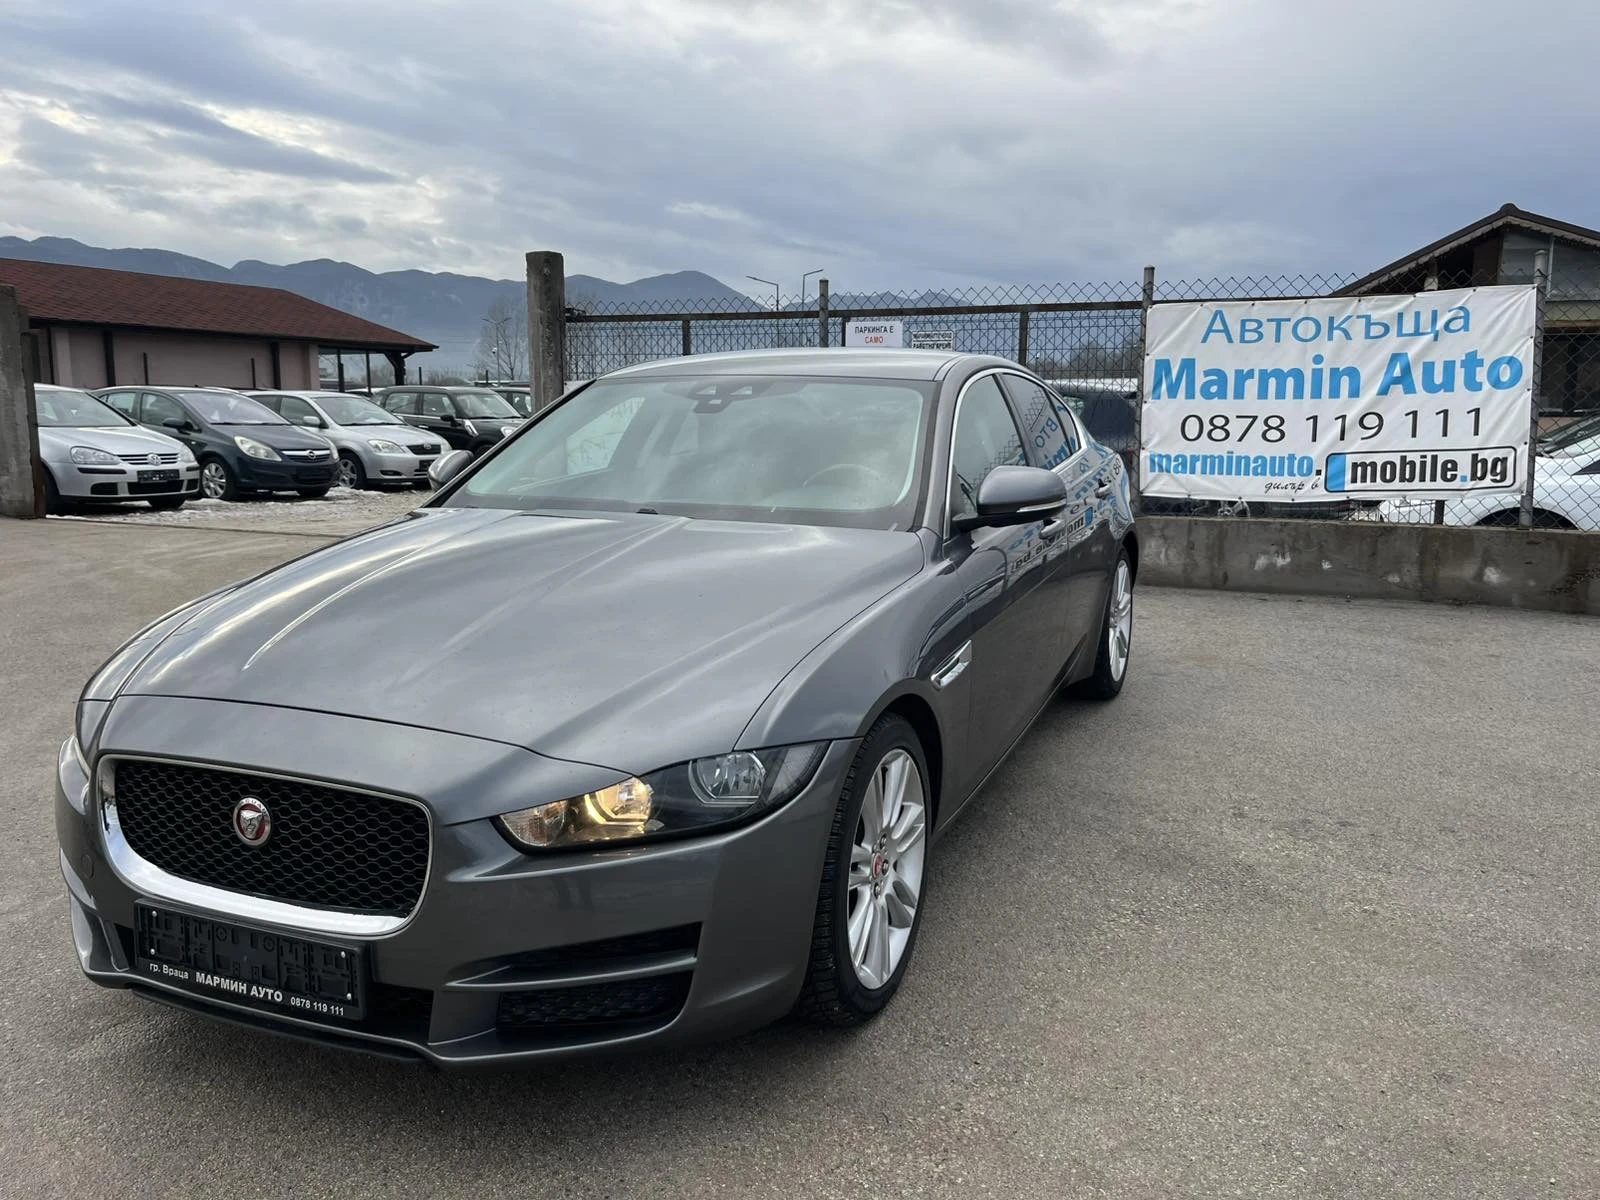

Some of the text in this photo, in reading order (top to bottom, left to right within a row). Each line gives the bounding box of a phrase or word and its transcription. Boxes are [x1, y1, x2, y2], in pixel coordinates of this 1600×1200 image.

[854, 325, 895, 334] ПАРКИНГА Е
[864, 336, 884, 344] САМО
[1200, 305, 1471, 344] Автокъща
[1151, 350, 1524, 401] Marmin Auto
[1180, 407, 1481, 443] 0878 119 111
[1350, 451, 1509, 484] mobile.bg
[149, 963, 344, 1016] гр. Враца МАРМИН АУТО 0878 119 111
